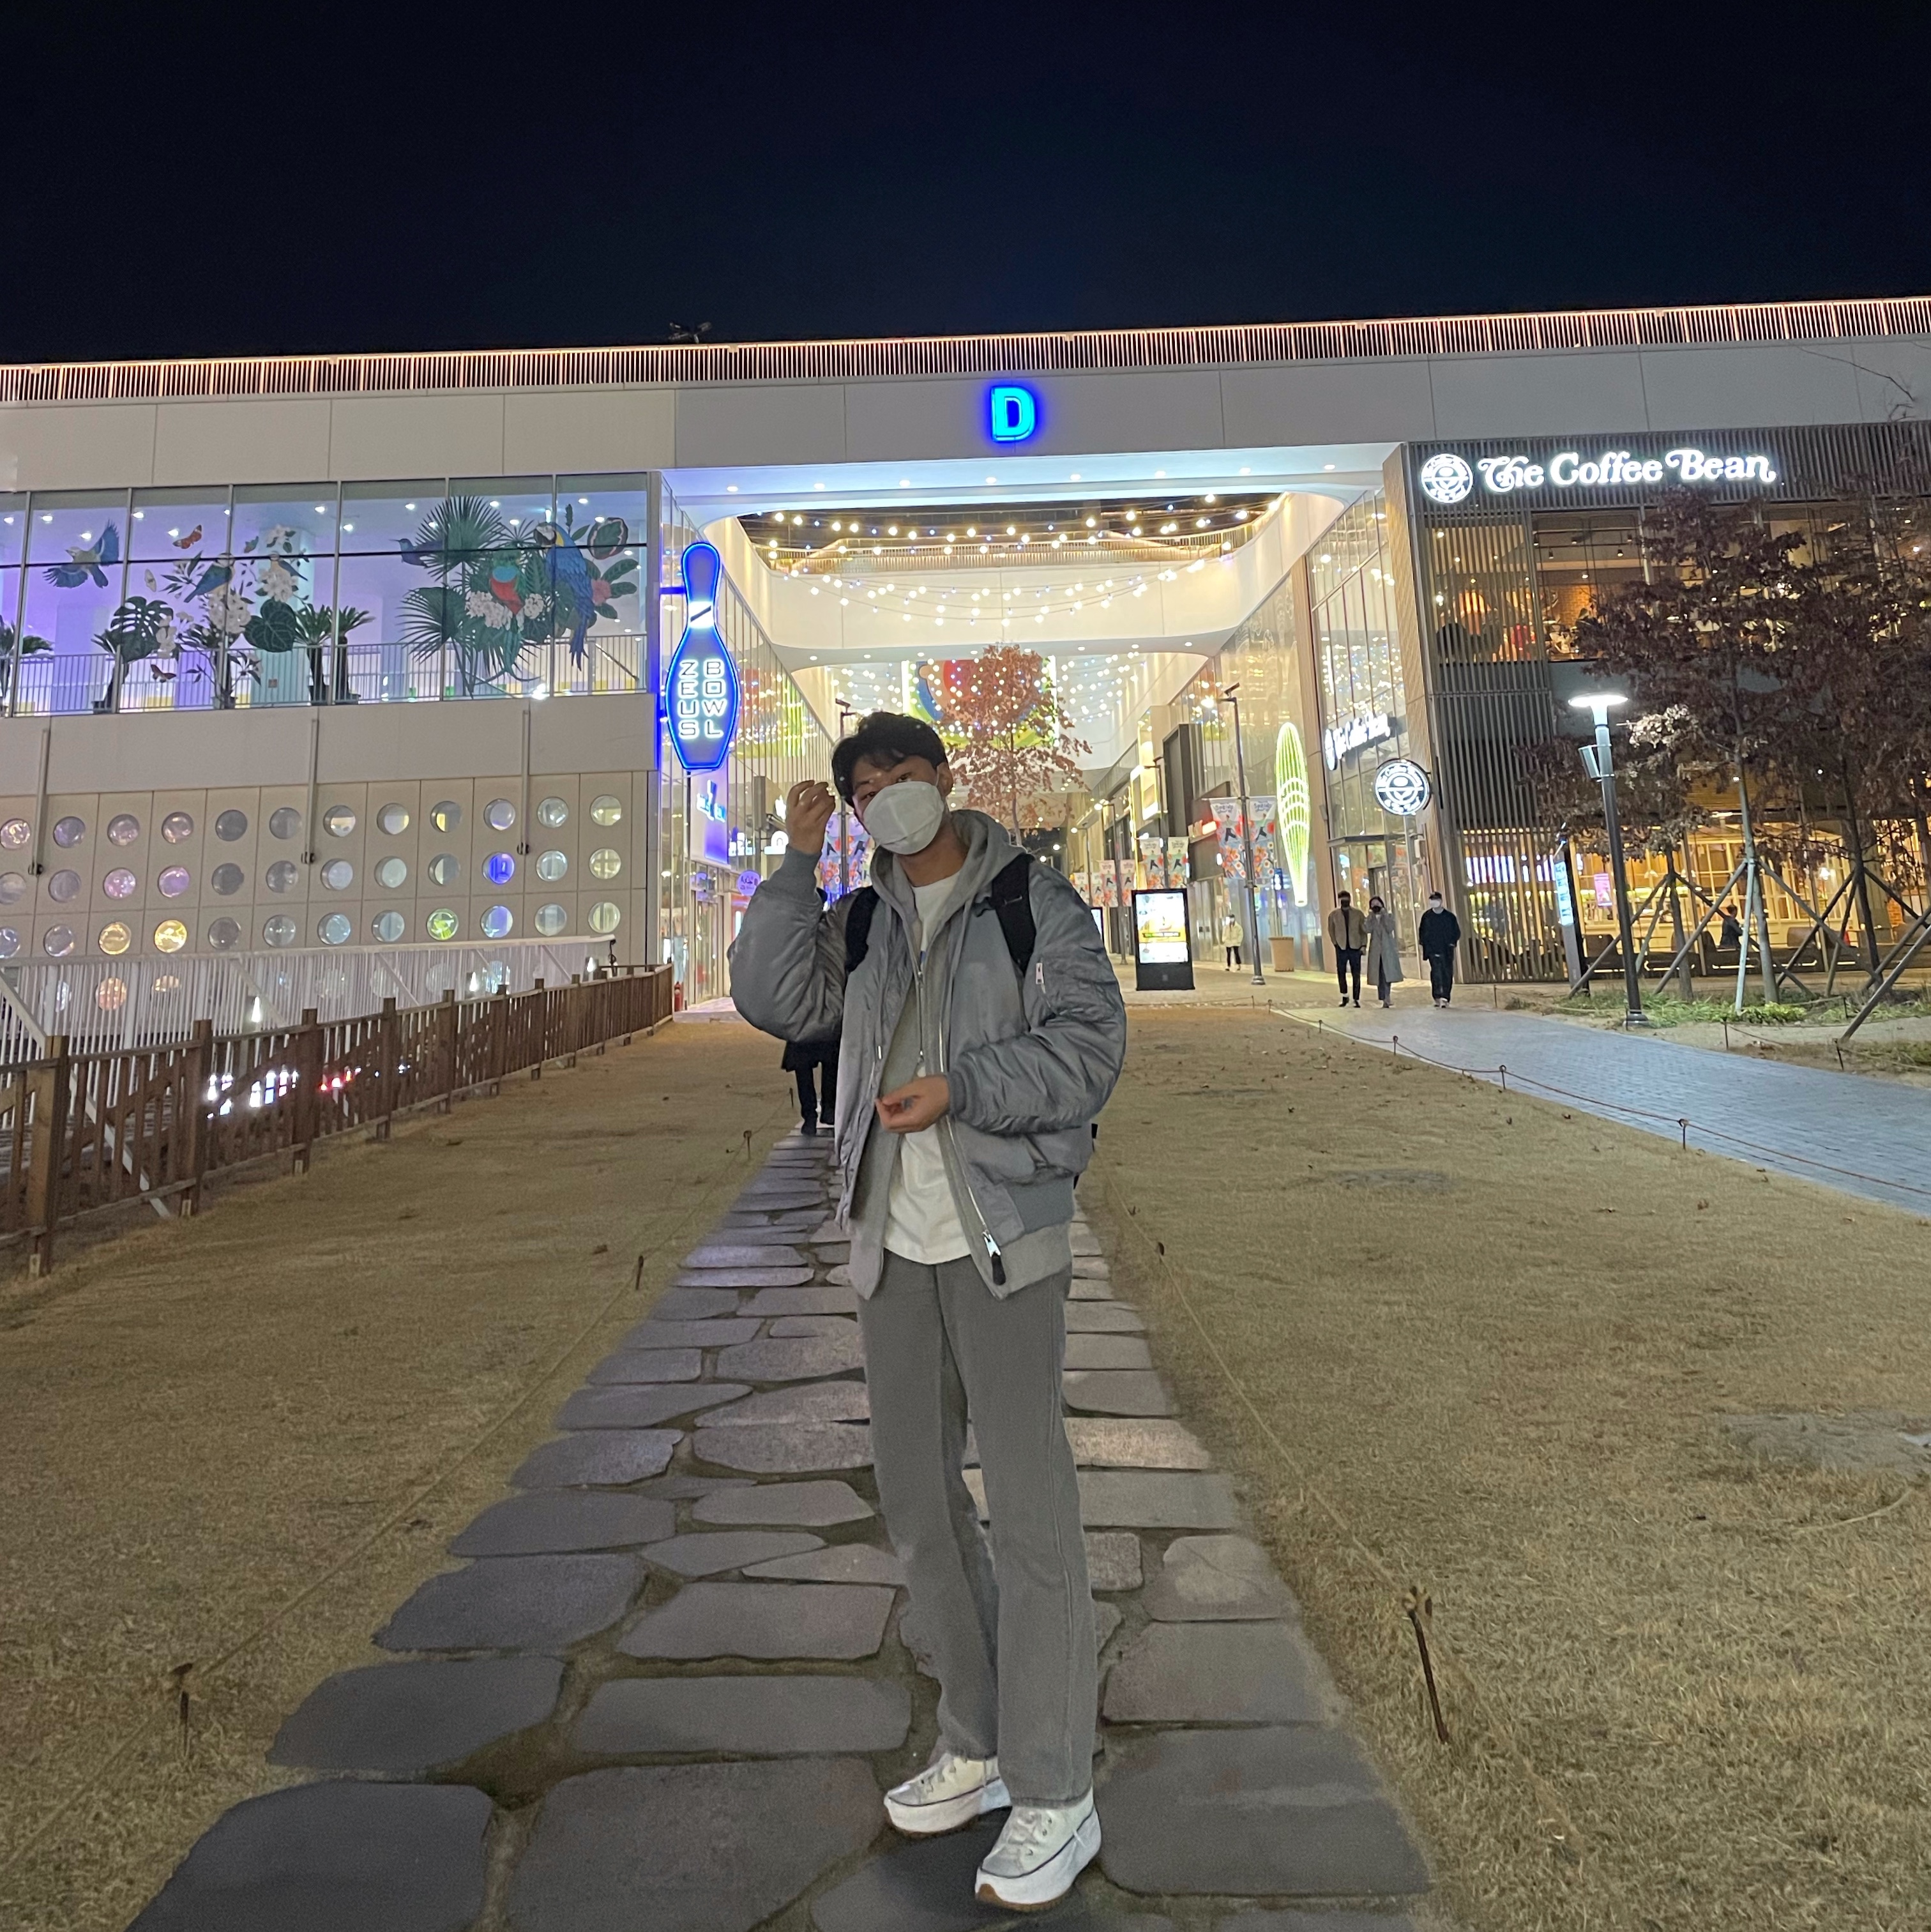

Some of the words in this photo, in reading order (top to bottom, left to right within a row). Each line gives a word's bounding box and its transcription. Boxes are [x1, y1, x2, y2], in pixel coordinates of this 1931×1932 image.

[990, 386, 1036, 442] D
[1477, 455, 1544, 493] The
[1550, 451, 1663, 486] Coffee
[1665, 449, 1777, 483] Bean
[678, 659, 700, 740] ZEUS
[702, 658, 727, 738] BOWL
